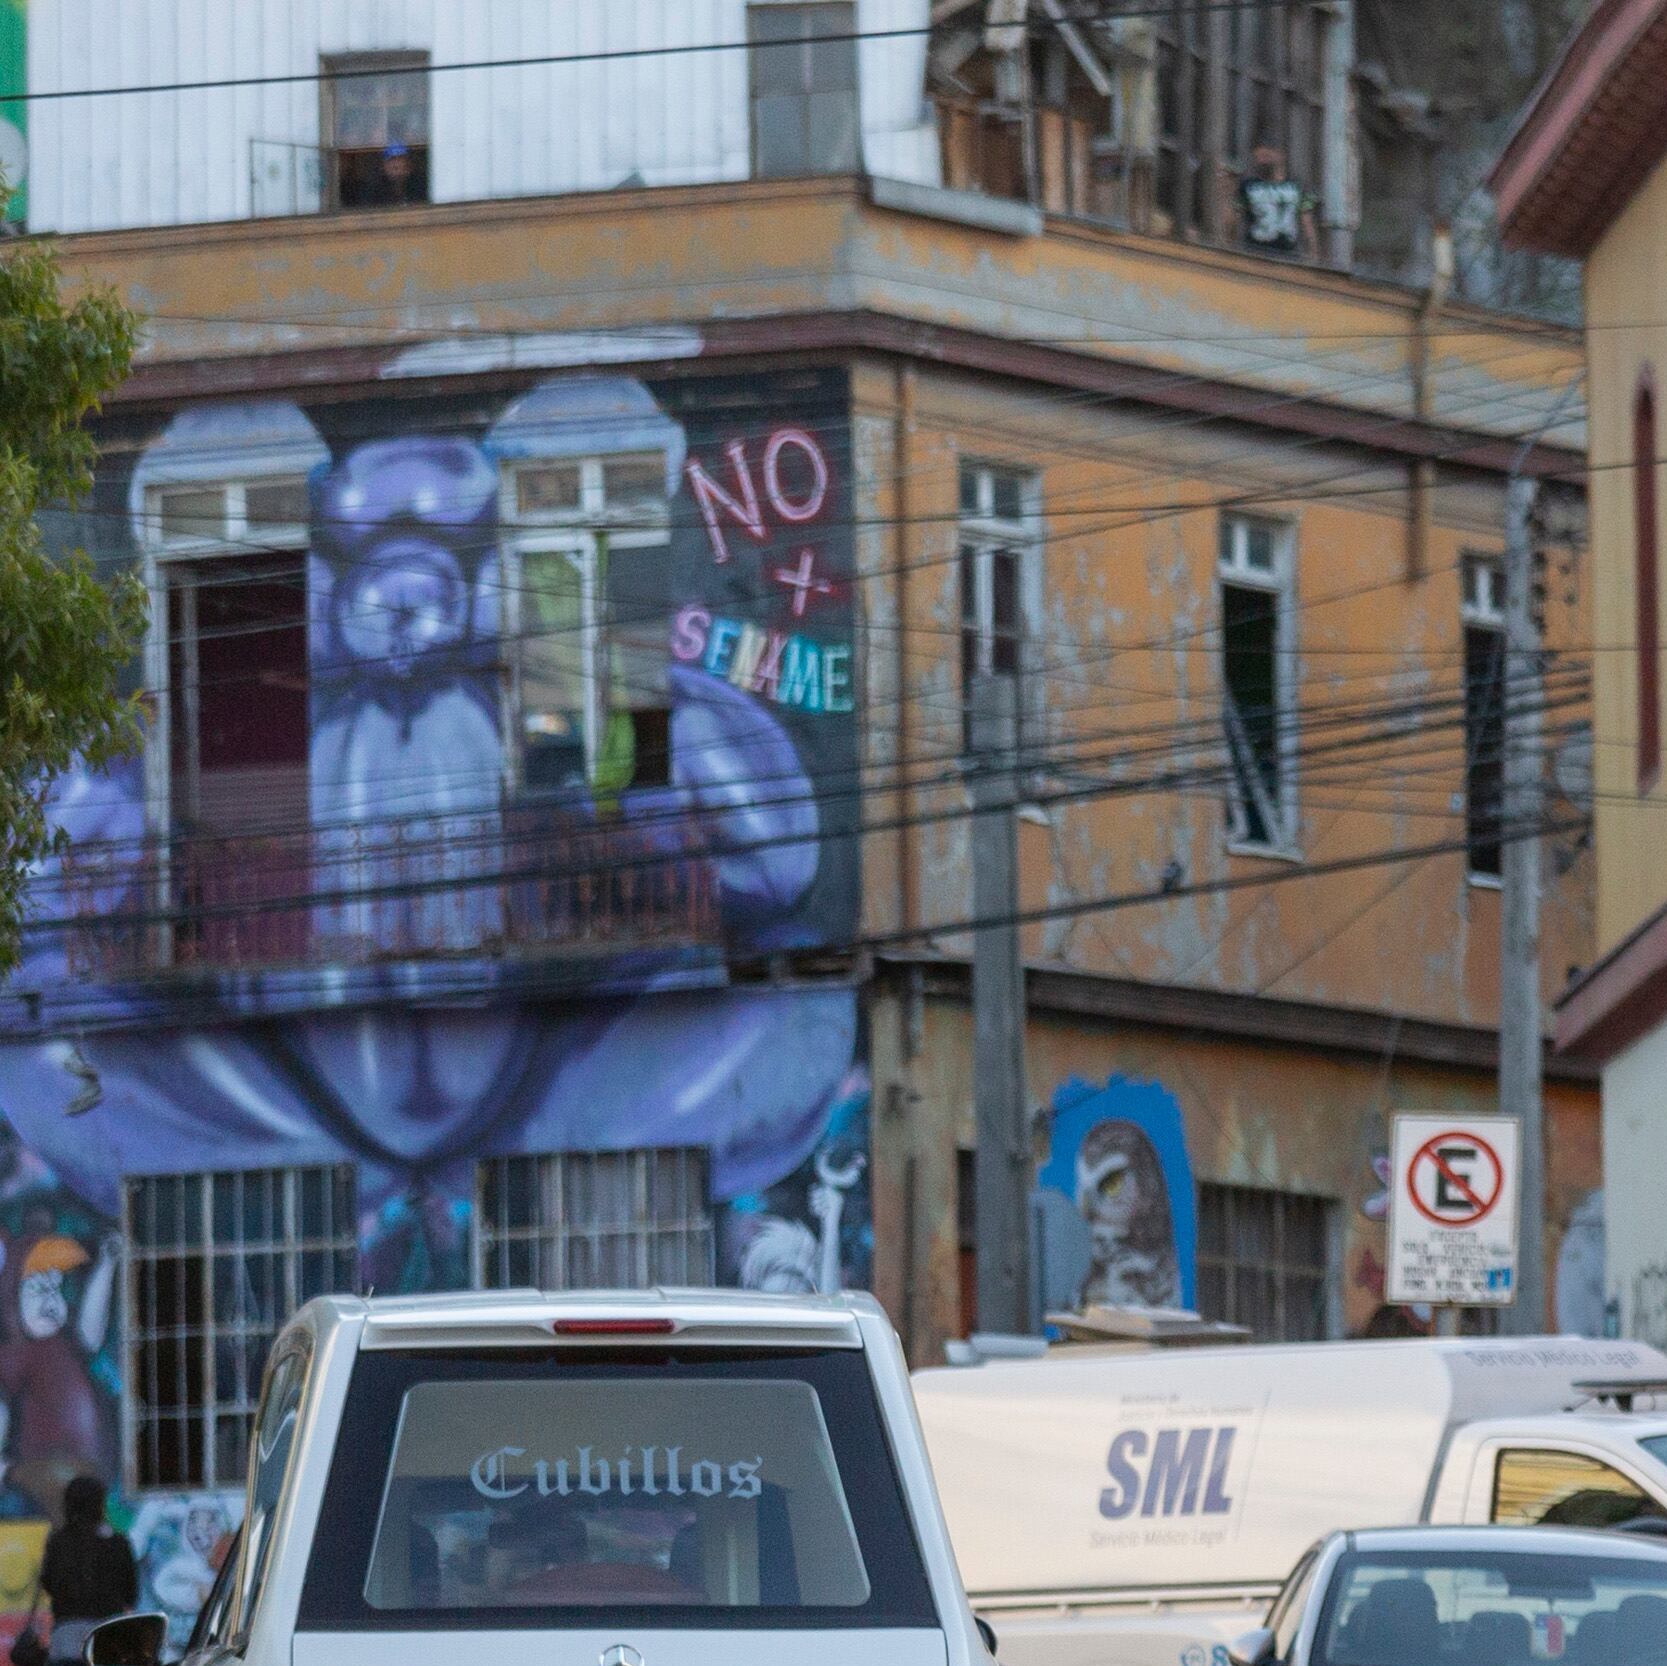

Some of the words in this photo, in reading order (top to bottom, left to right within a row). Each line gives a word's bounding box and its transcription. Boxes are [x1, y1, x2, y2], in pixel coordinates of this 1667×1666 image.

[684, 428, 829, 563] NO
[1437, 1148, 1477, 1209] E
[470, 1445, 764, 1499] Cubillos
[1098, 1427, 1238, 1522] SML
